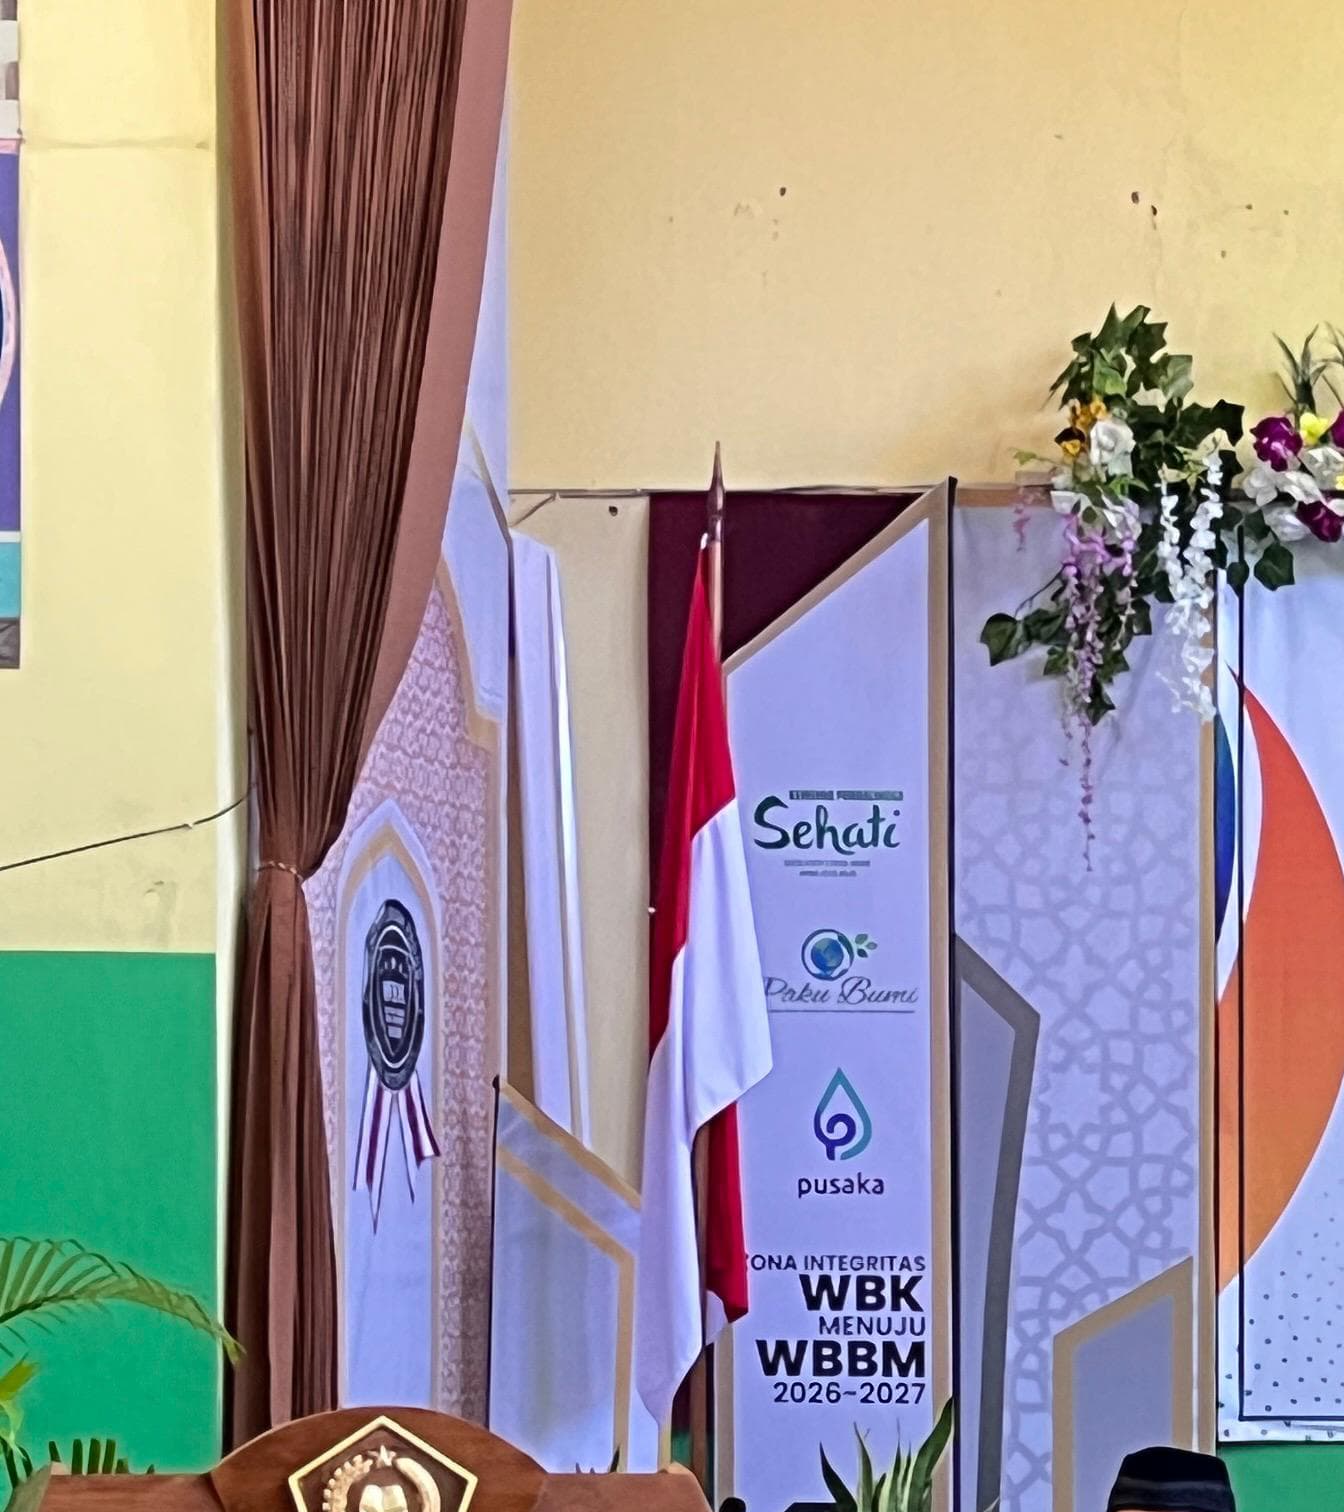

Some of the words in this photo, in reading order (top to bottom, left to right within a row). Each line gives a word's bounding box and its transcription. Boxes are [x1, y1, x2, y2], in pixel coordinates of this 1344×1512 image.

[754, 796, 900, 855] Sehati
[837, 976, 919, 1005] Bumi
[798, 1172, 884, 1198] pusaka
[745, 1254, 796, 1270] ONA
[804, 1254, 925, 1271] INTEGRITAS
[799, 1274, 923, 1312] WBK
[818, 1315, 925, 1336] MENUJU
[756, 1340, 925, 1377] WBBM
